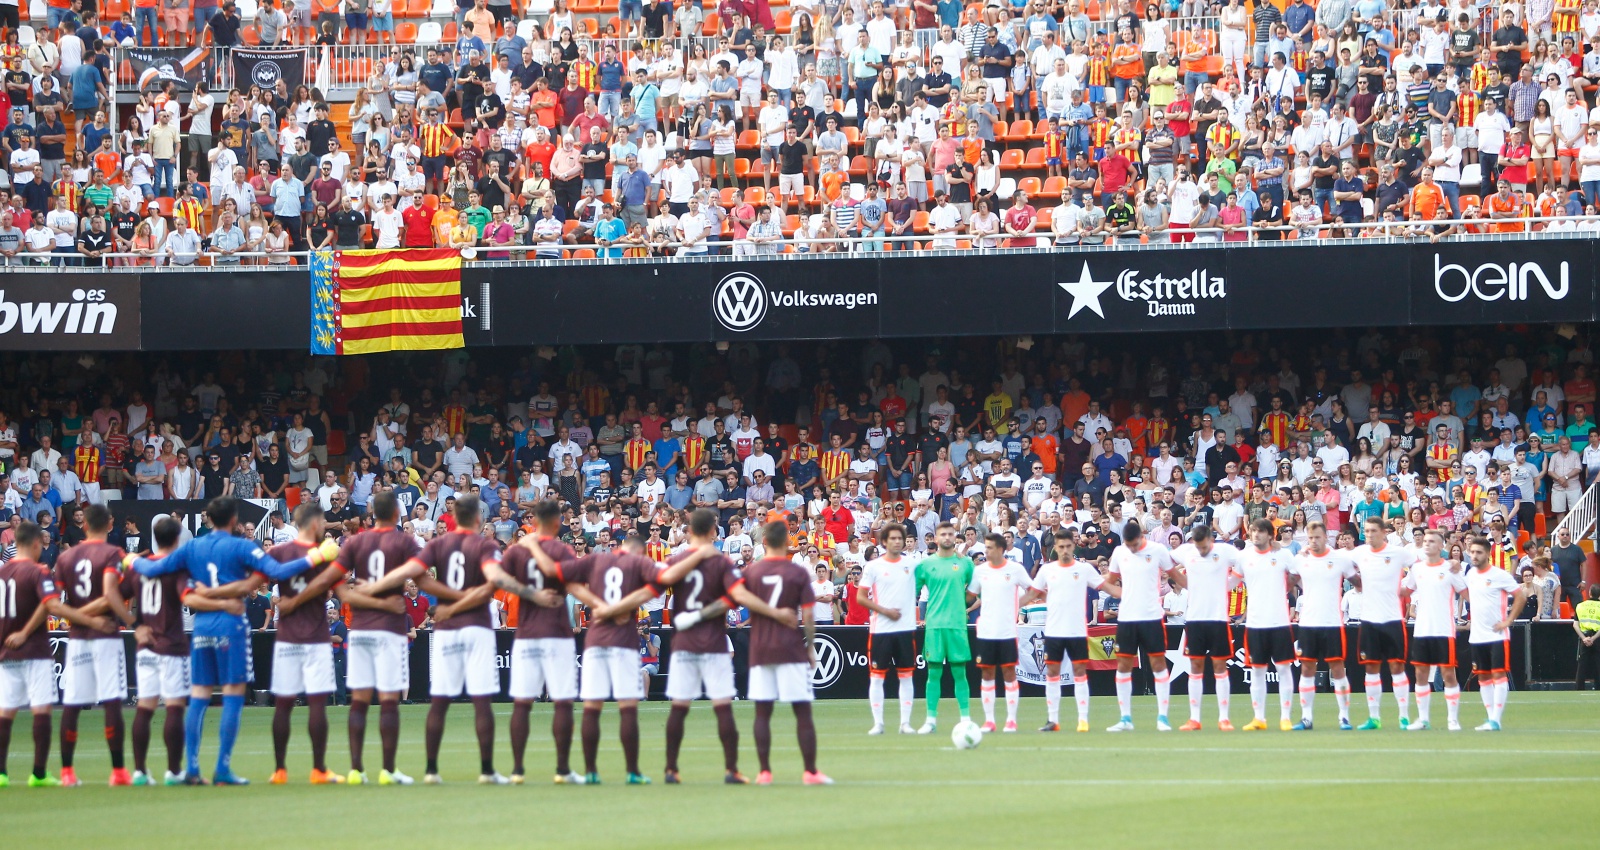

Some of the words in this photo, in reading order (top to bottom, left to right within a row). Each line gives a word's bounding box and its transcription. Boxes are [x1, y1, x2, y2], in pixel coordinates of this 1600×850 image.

[1116, 268, 1227, 302] Estrella
[1434, 252, 1570, 303] beIN
[0, 288, 118, 335] bwin
[770, 290, 878, 310] Volkswagen
[1147, 299, 1196, 317] Damm
[260, 499, 272, 507] 121
[75, 558, 93, 598] 3
[367, 549, 385, 584] 9
[446, 550, 466, 591] 6
[604, 566, 624, 606] 8
[140, 574, 162, 615] 10
[685, 570, 704, 610] 2
[762, 575, 783, 609] 7
